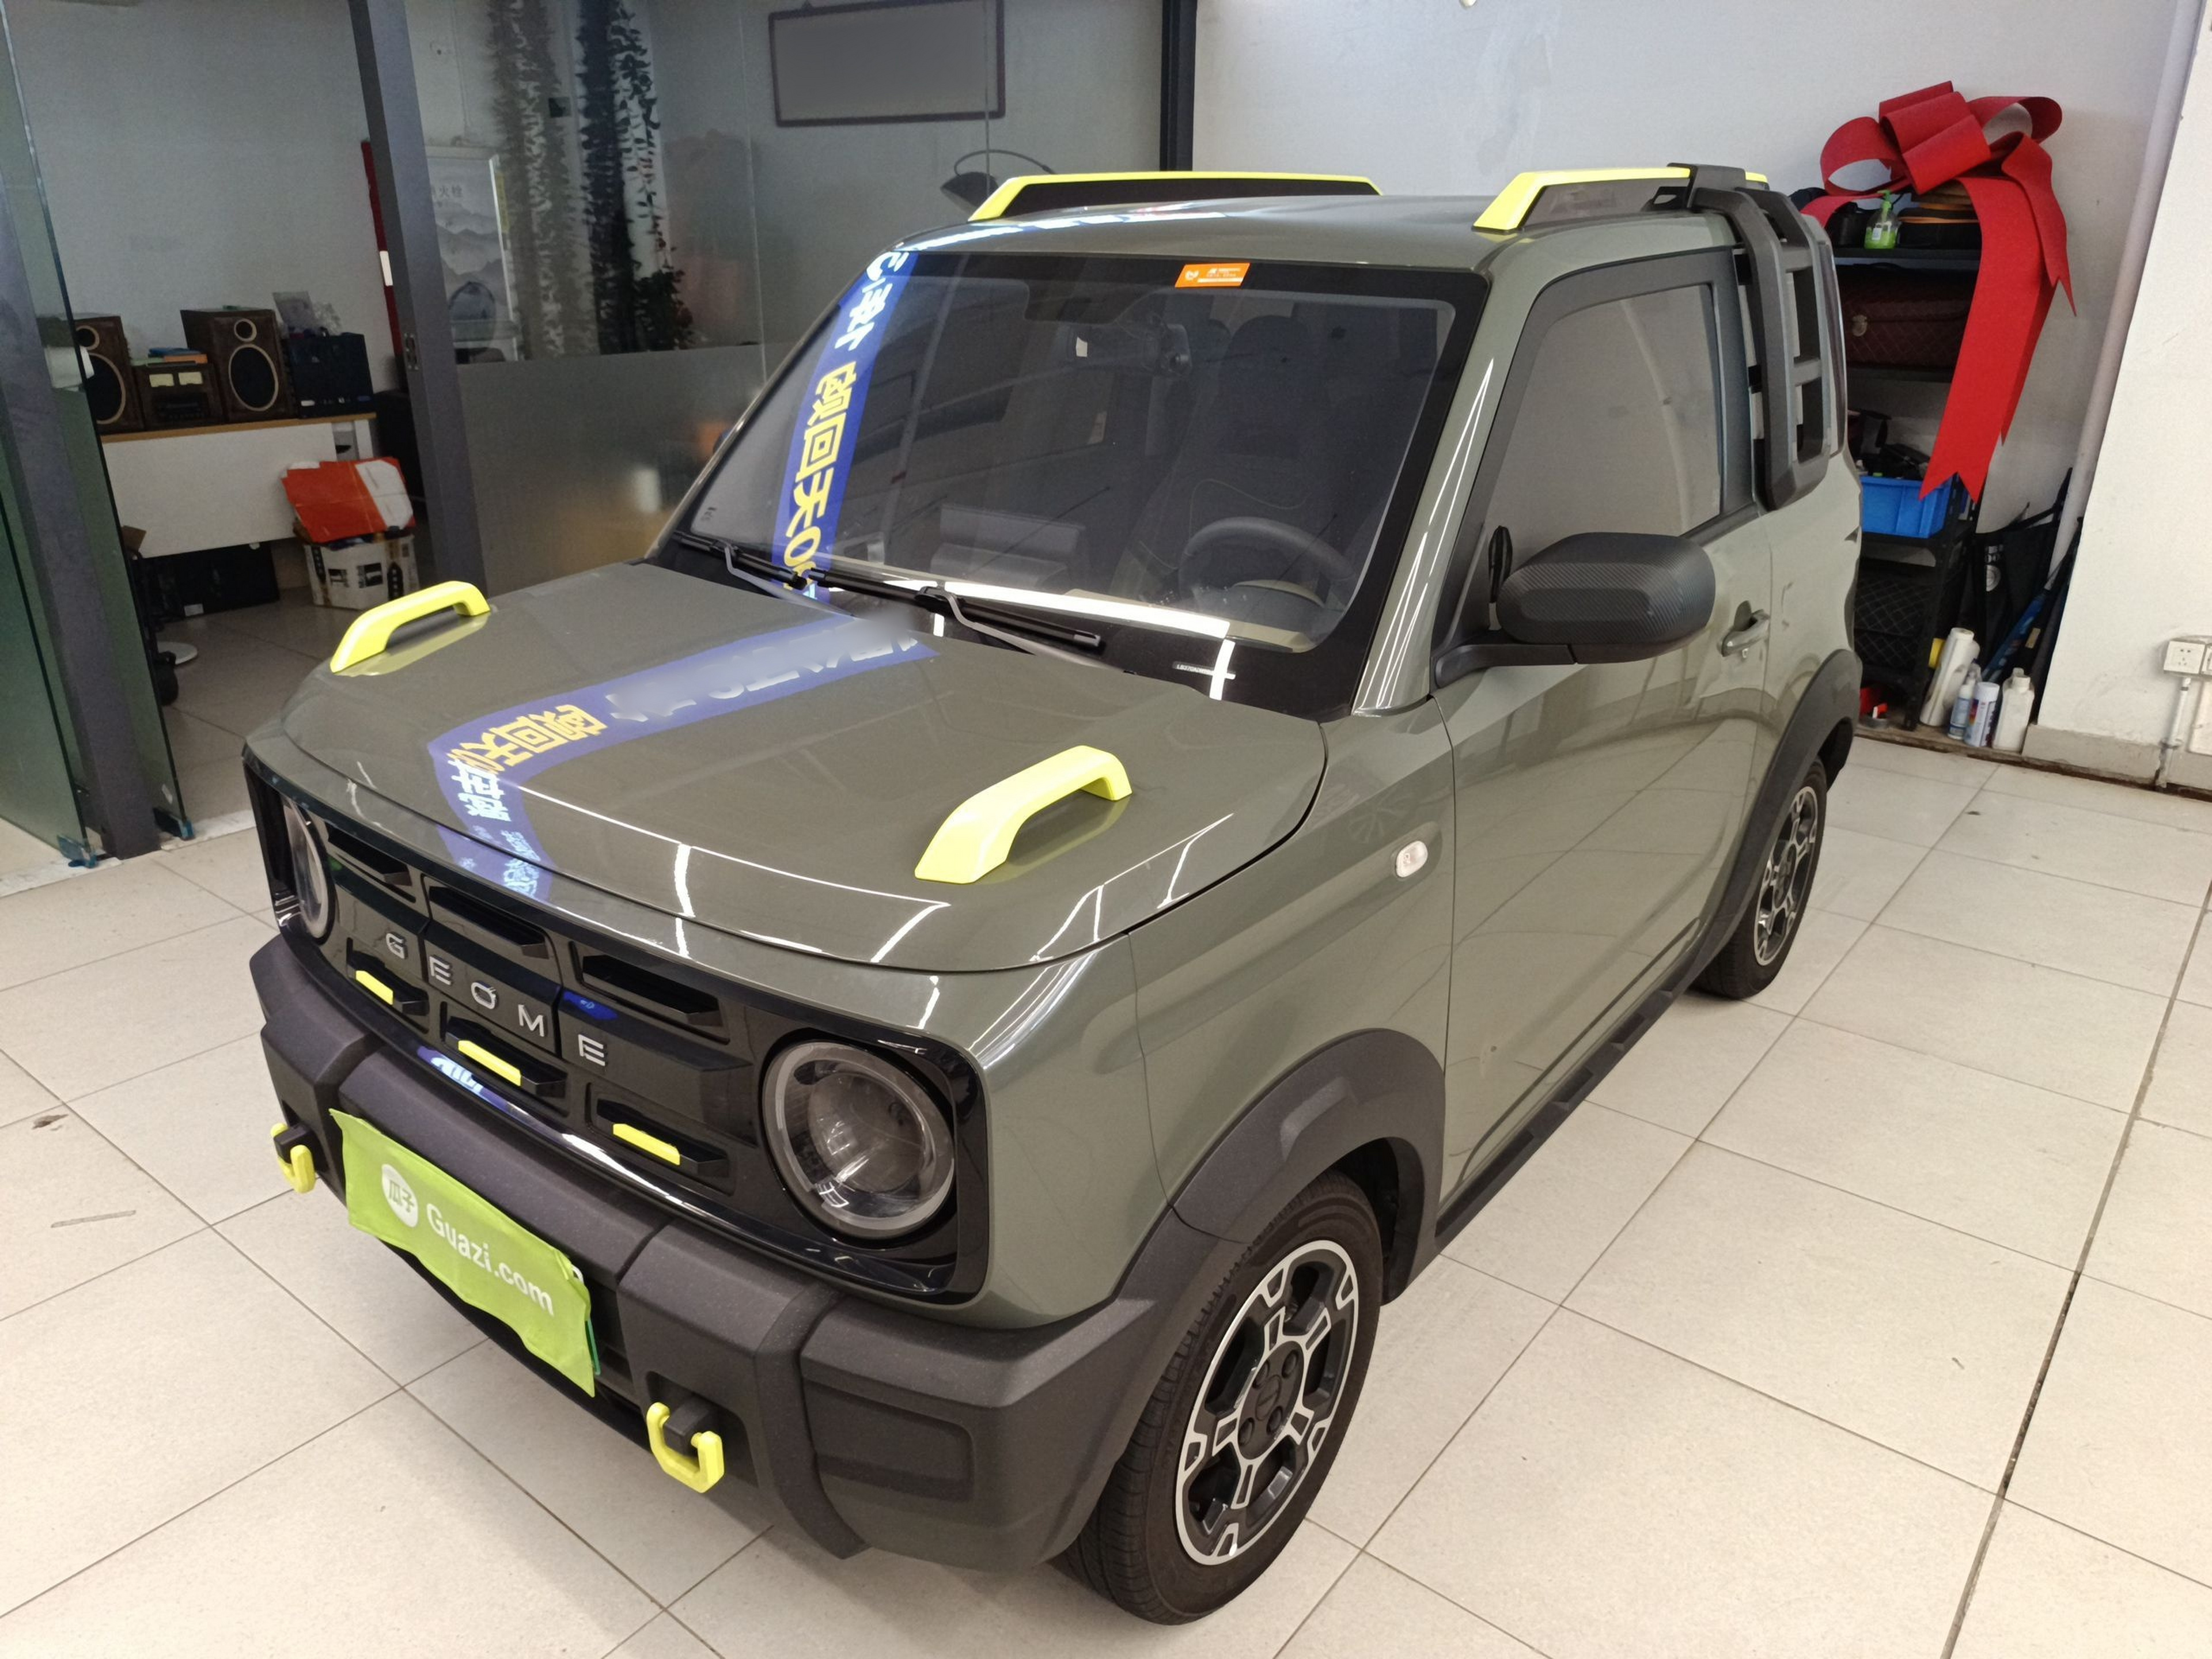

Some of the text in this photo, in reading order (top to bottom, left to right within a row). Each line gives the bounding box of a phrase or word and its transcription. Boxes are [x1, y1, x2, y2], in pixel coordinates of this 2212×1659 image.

[385, 932, 607, 1067] GEOME
[389, 1180, 415, 1213] 瓜子
[426, 1203, 555, 1317] Guazi.com
